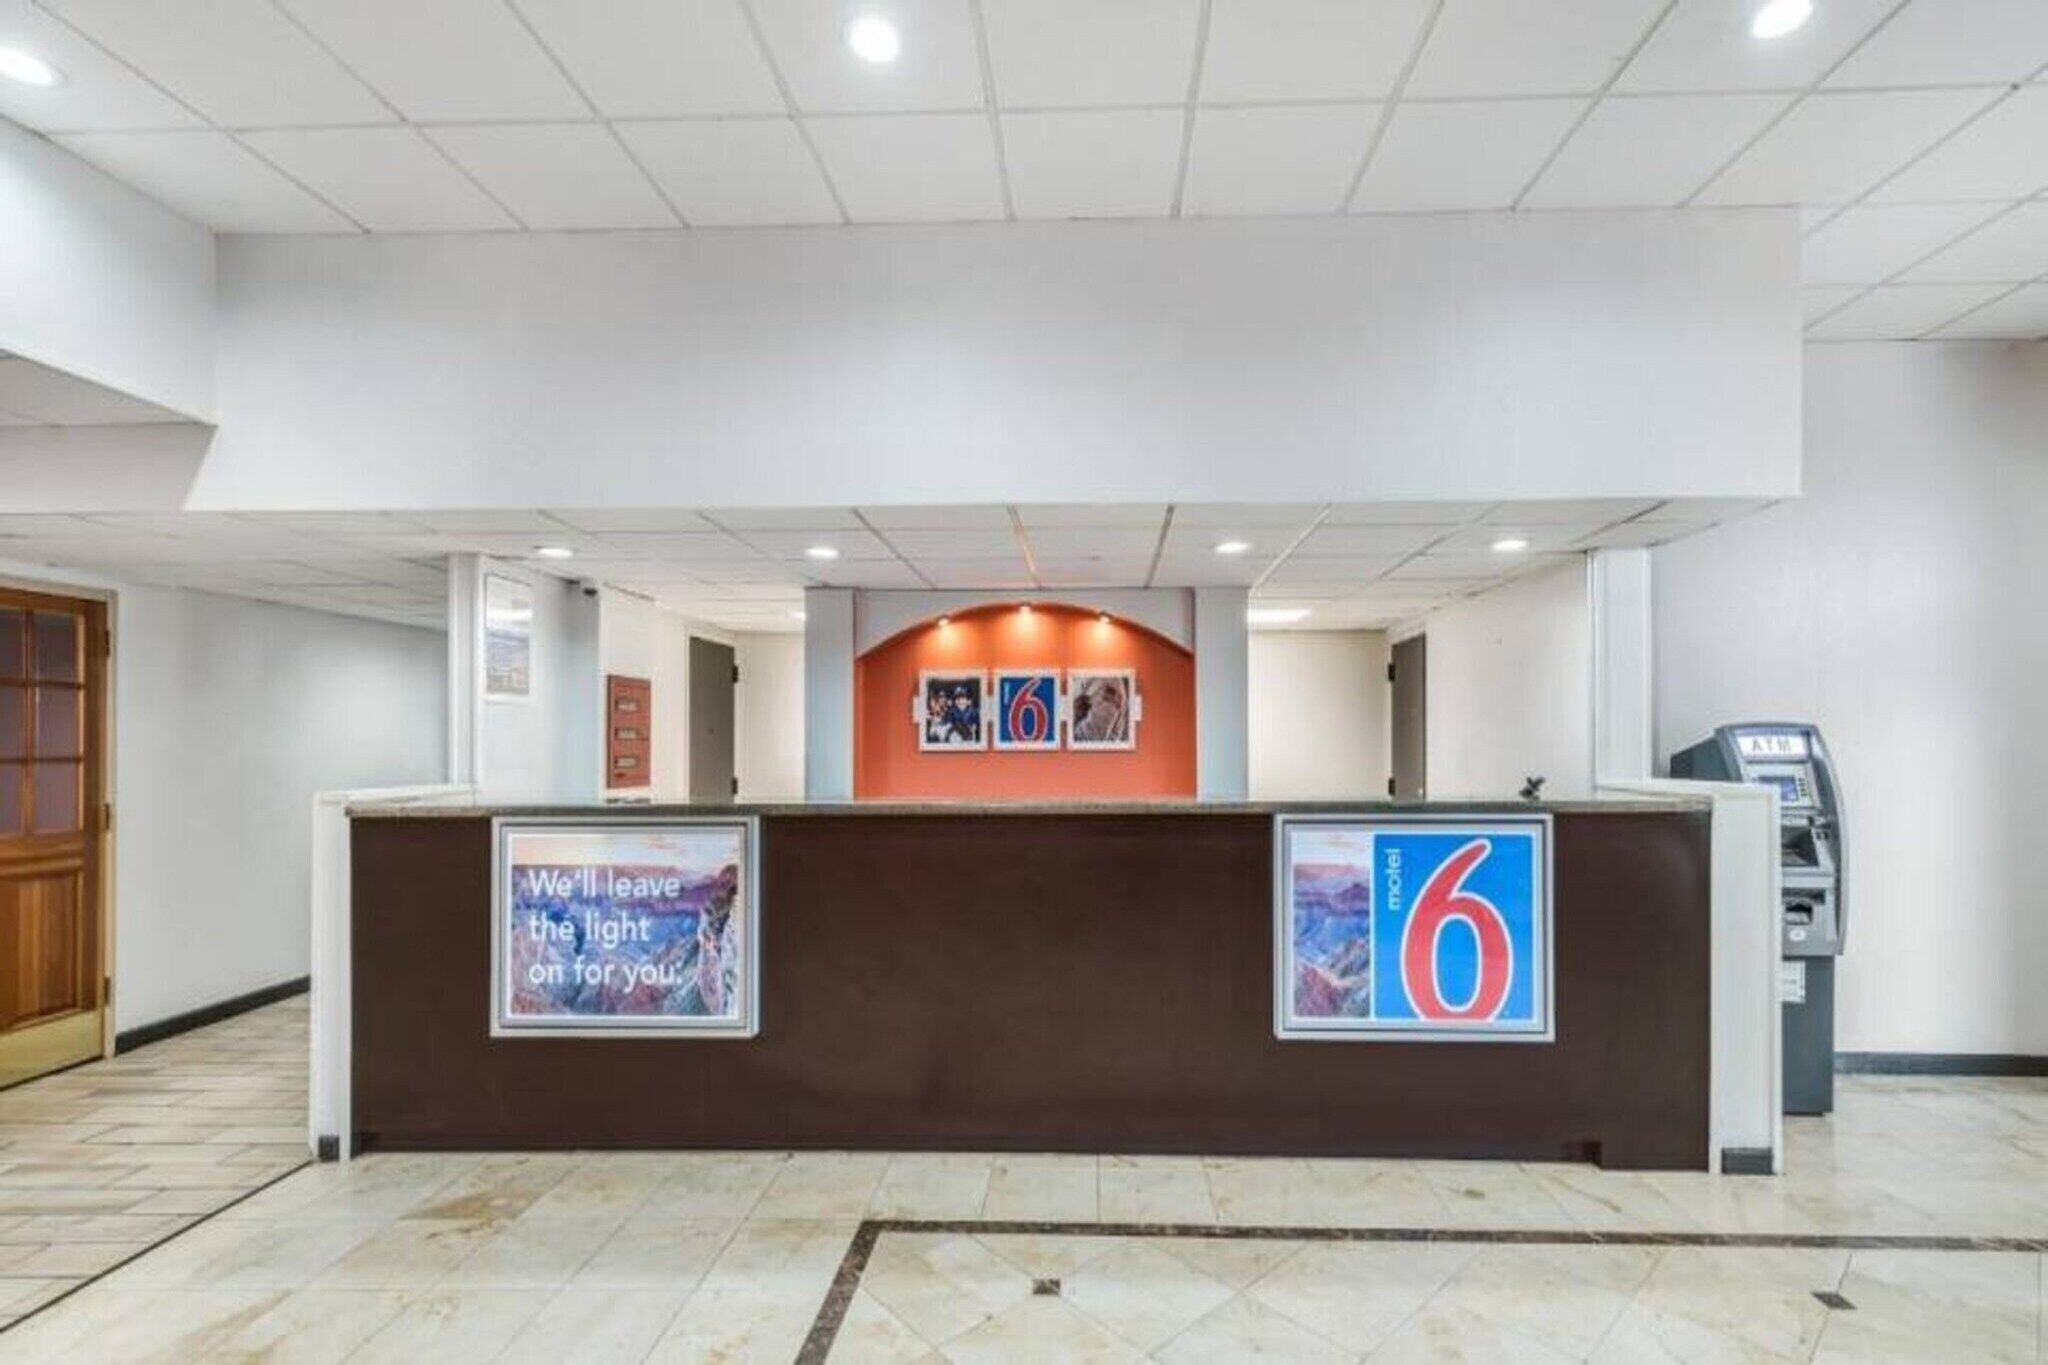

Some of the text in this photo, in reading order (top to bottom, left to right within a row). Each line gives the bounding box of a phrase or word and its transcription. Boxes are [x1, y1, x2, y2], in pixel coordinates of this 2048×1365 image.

[1008, 678, 1048, 742] 6
[1751, 736, 1792, 753] ATM
[528, 868, 682, 898] We'll leave
[1385, 848, 1401, 911] motel
[529, 910, 651, 949] the light
[1401, 838, 1514, 1022] 6
[528, 963, 563, 984] on
[575, 955, 615, 984] for
